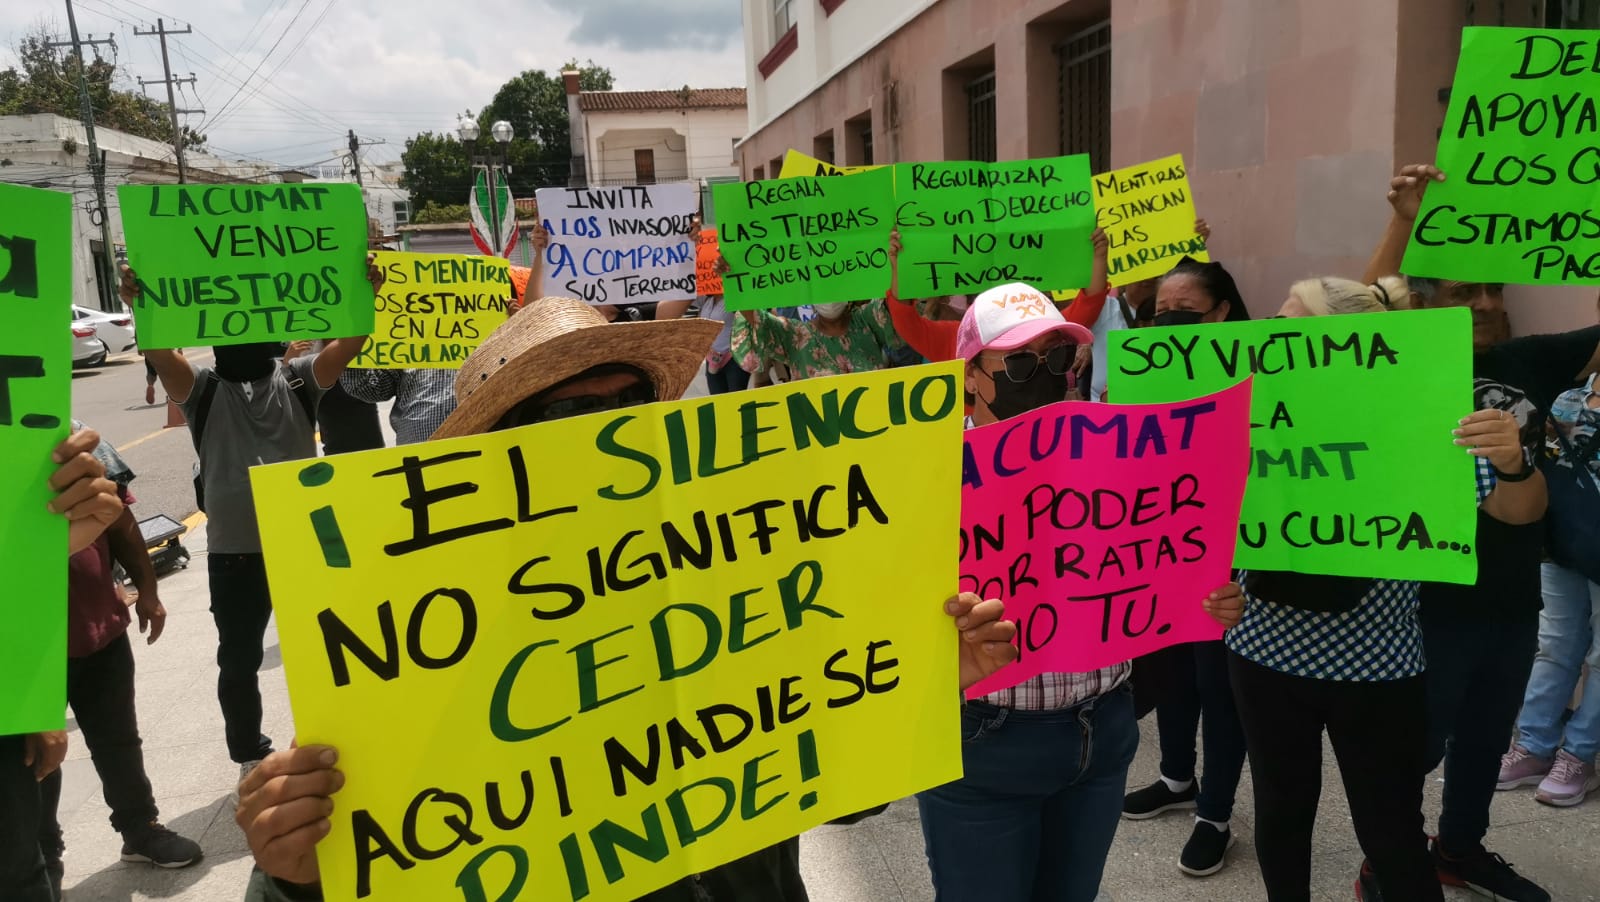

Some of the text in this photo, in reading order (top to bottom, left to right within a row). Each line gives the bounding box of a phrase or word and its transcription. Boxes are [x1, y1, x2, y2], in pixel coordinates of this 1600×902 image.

[911, 163, 1063, 191] REGULARIZAR
[1095, 164, 1186, 198] MENTIRAS
[1466, 151, 1556, 186] LOS
[566, 187, 653, 209] INVITA
[745, 178, 825, 210] REGALA
[977, 190, 1091, 223] DERECHO
[1096, 187, 1186, 230] ESTANCAN
[194, 224, 339, 259] VENDE
[561, 215, 602, 238] LOS
[721, 207, 879, 244] LAS TIERRAS
[1109, 224, 1149, 249] LAS
[1415, 205, 1600, 247] ESTAMOS
[583, 241, 694, 276] COMPRAR
[744, 239, 838, 268] QUE NO
[952, 233, 1044, 255] NO UN
[136, 266, 343, 309] NUESTROS
[725, 248, 888, 293] TIENEN DUEÑO
[565, 274, 696, 303] SUS TERRENOS
[196, 306, 332, 340] LOTES
[390, 314, 480, 340] EN LAS
[1119, 331, 1399, 381] SOY VICTIMA
[596, 373, 957, 501] SILENCIO
[1023, 474, 1206, 540] PODER
[1054, 526, 1208, 580] RATAS
[317, 463, 890, 688] NO SIGNIFICA
[1067, 584, 1172, 643] TU.
[488, 560, 844, 743] CEDER
[350, 639, 901, 899] AQUI NADIE SE
